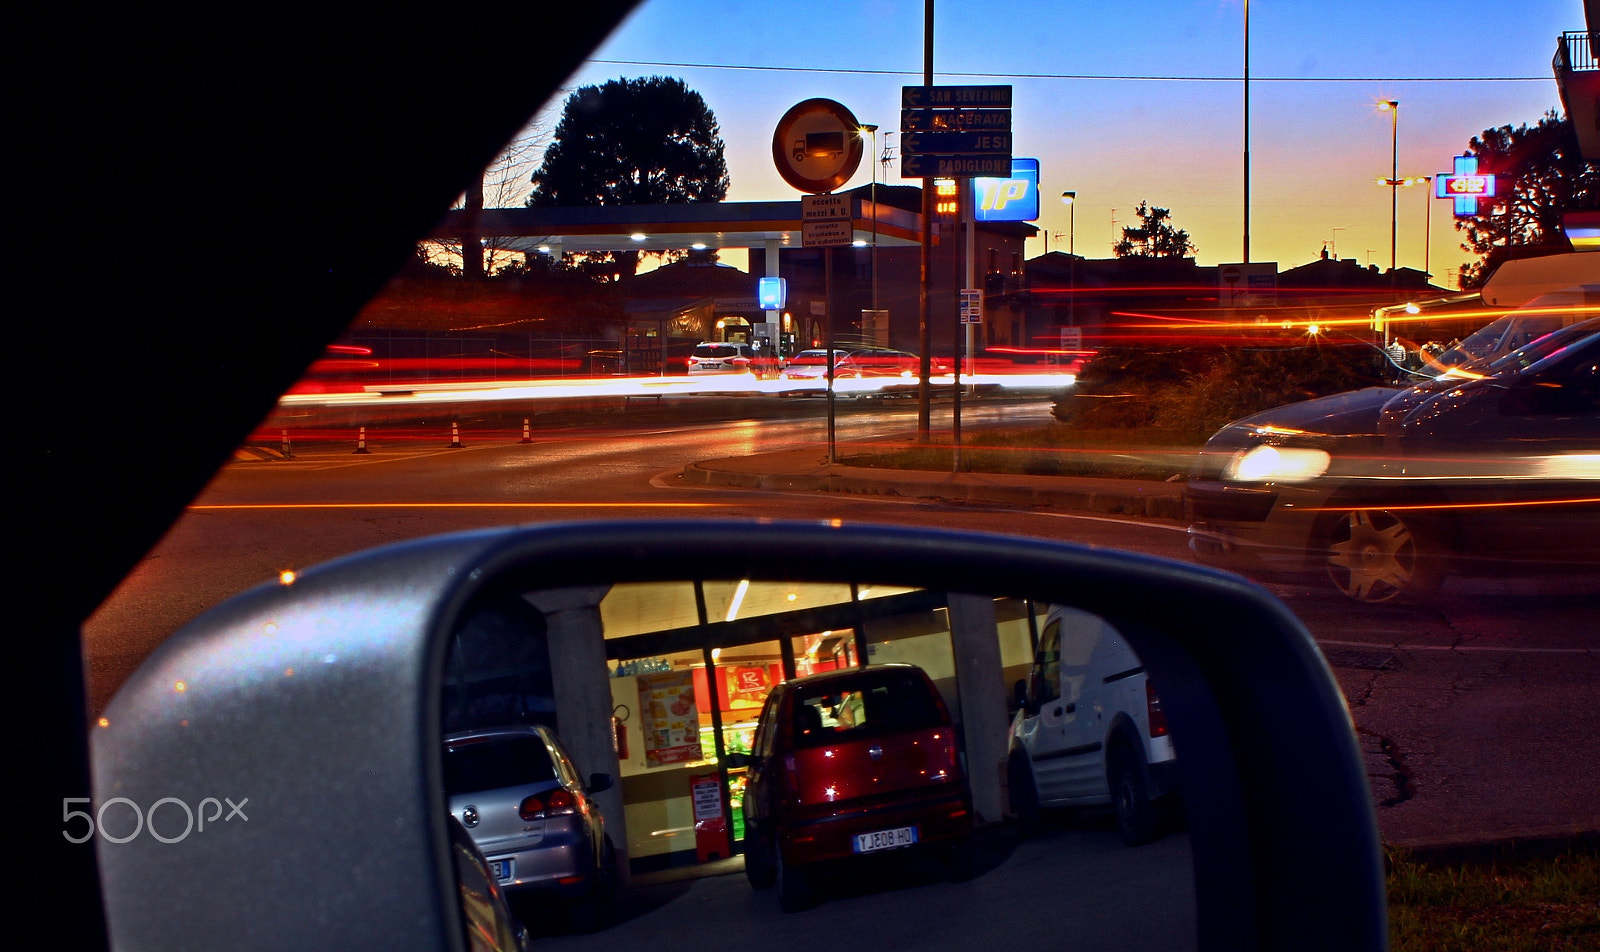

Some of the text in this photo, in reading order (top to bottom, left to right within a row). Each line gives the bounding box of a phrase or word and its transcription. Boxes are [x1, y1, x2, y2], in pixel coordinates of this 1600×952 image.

[930, 89, 1008, 102] SAN SEVERINO
[974, 136, 1007, 149] JESI
[939, 159, 1008, 172] PADIGLIONE
[981, 179, 1029, 211] IP
